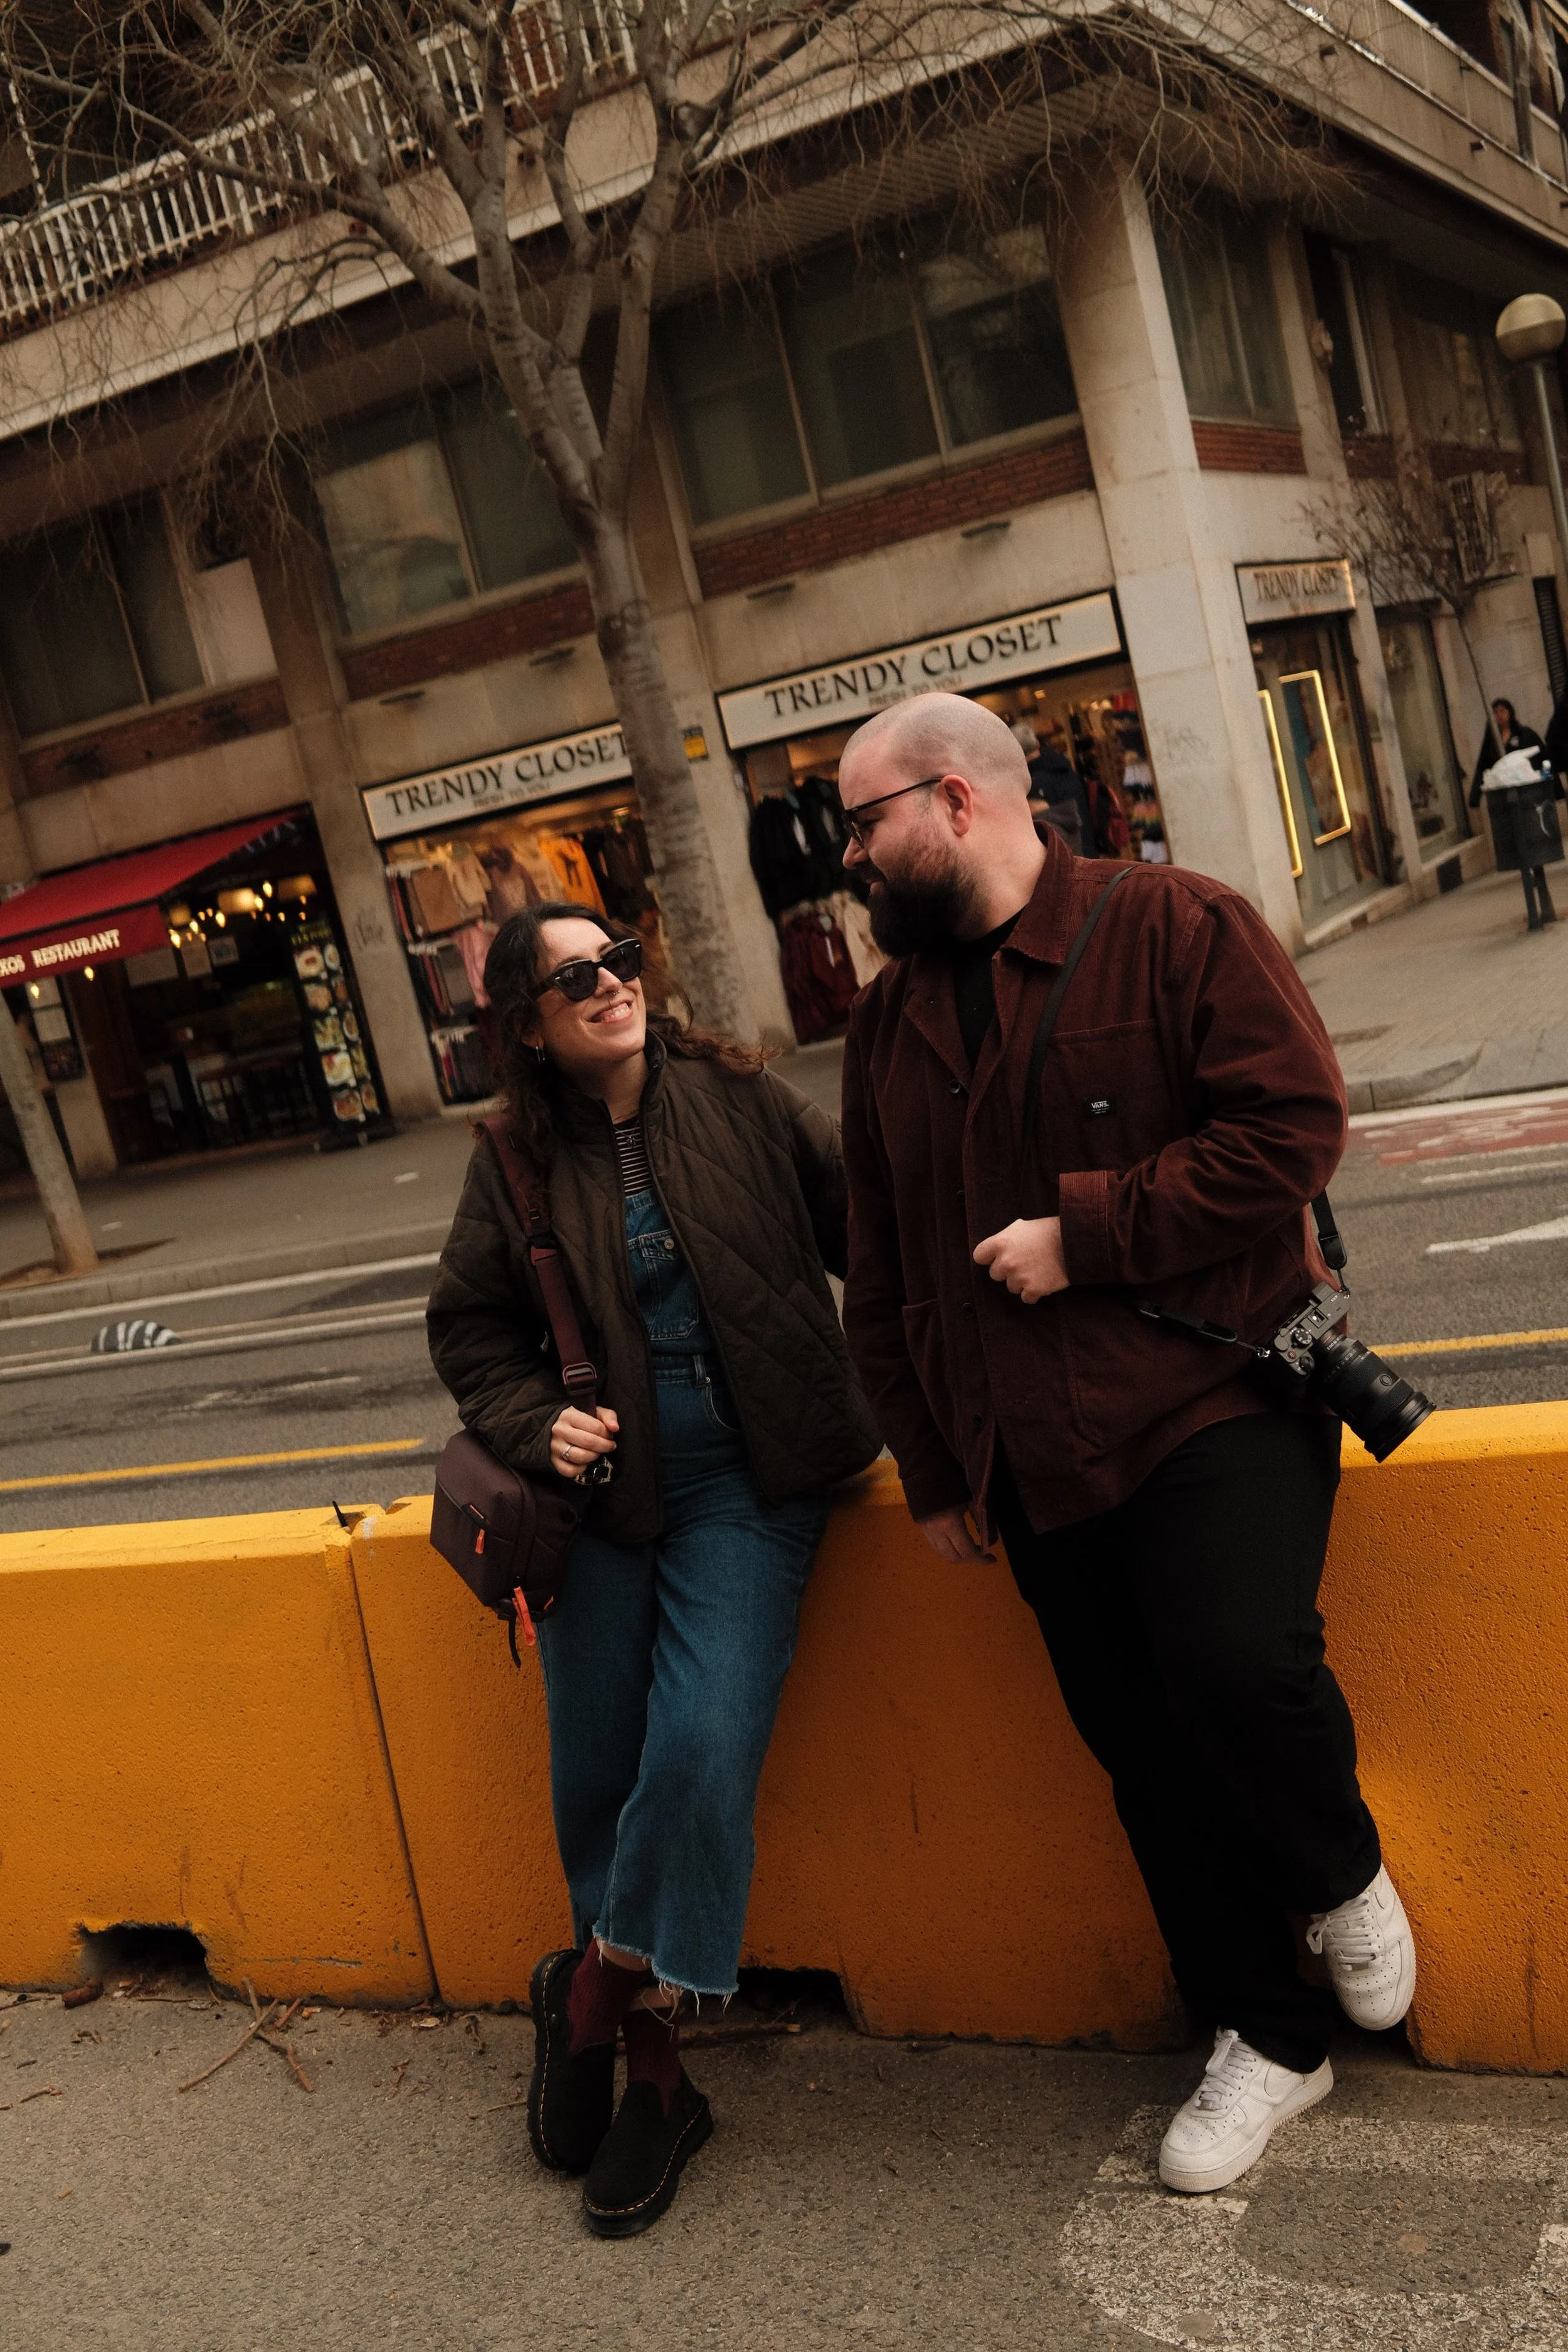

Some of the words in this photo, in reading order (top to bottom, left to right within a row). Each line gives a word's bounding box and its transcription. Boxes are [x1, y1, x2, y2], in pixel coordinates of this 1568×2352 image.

[764, 654, 908, 718] TRENDY
[921, 613, 1062, 677] CLOSET
[385, 764, 502, 817] TRENDY
[514, 731, 628, 782] CLOSET
[0, 954, 25, 978] XOS
[31, 928, 120, 968] RESTAURANT
[1091, 1101, 1108, 1109] VANS
